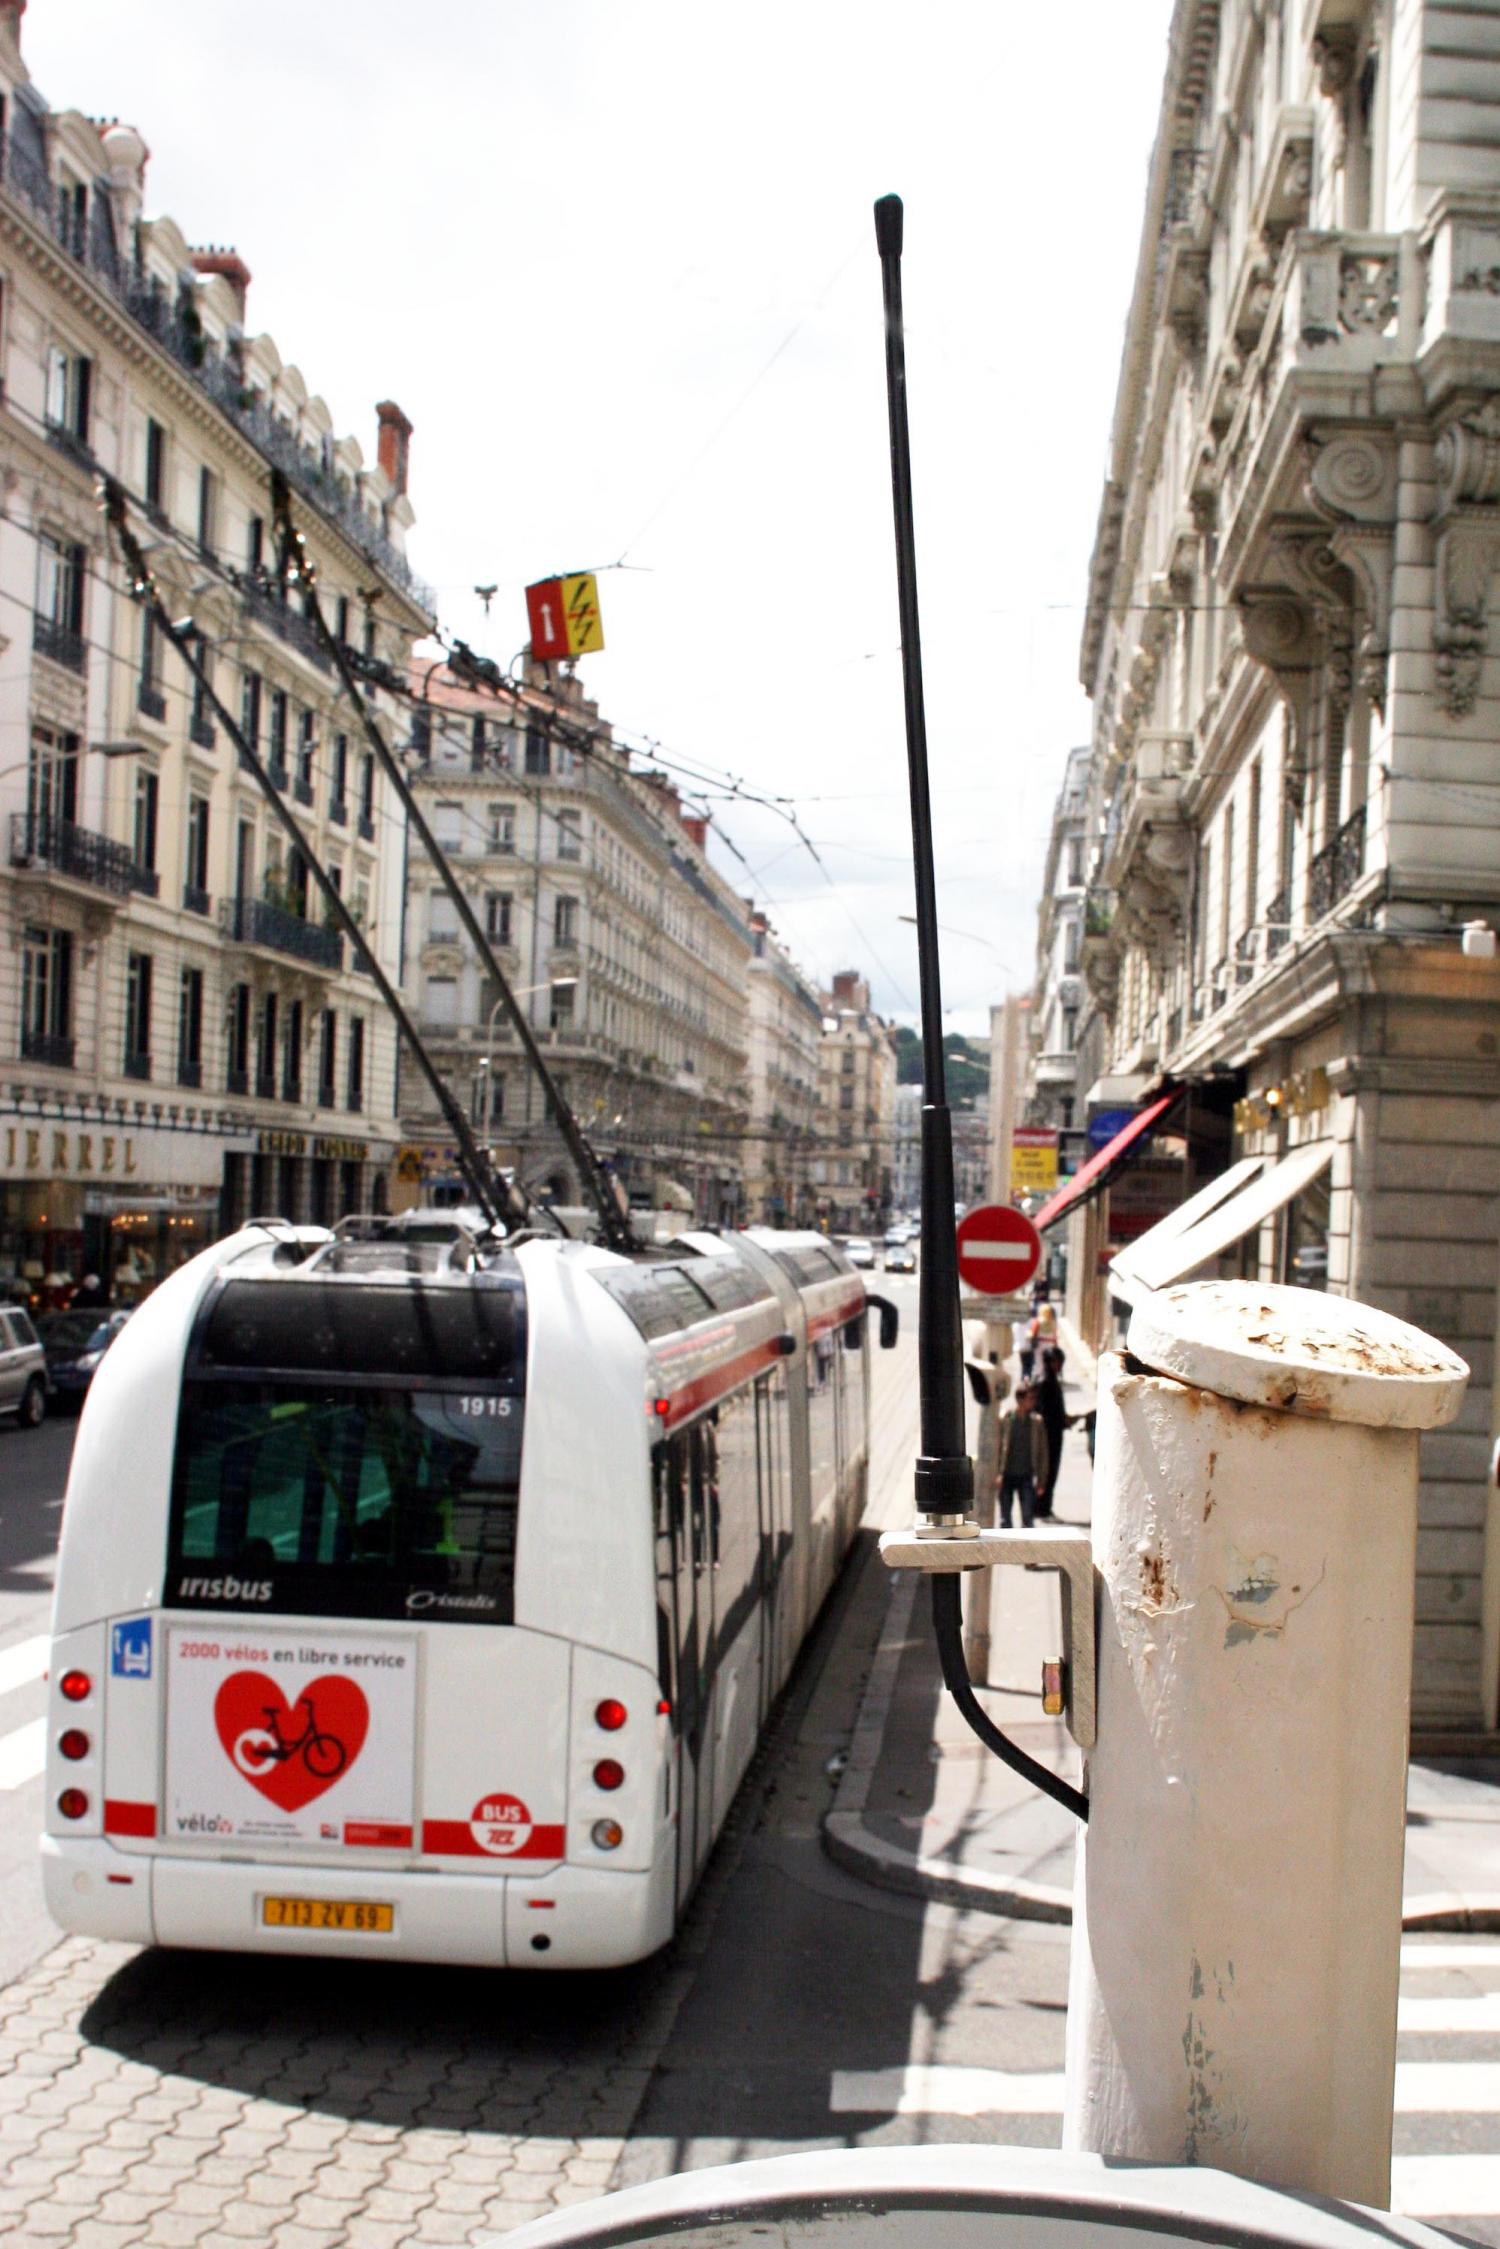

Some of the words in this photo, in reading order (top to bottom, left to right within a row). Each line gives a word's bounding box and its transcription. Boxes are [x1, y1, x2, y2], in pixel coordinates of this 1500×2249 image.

[459, 1395, 511, 1417] 1915
[179, 1576, 273, 1601] irisbus
[179, 1641, 220, 1659] 2000
[224, 1643, 269, 1662] vélos
[273, 1649, 295, 1663] en
[298, 1646, 339, 1665] libre
[343, 1652, 406, 1669] service
[481, 1803, 521, 1822] BUS
[278, 1901, 313, 1925] 713
[322, 1902, 346, 1927] ZV
[354, 1905, 378, 1929] 69
